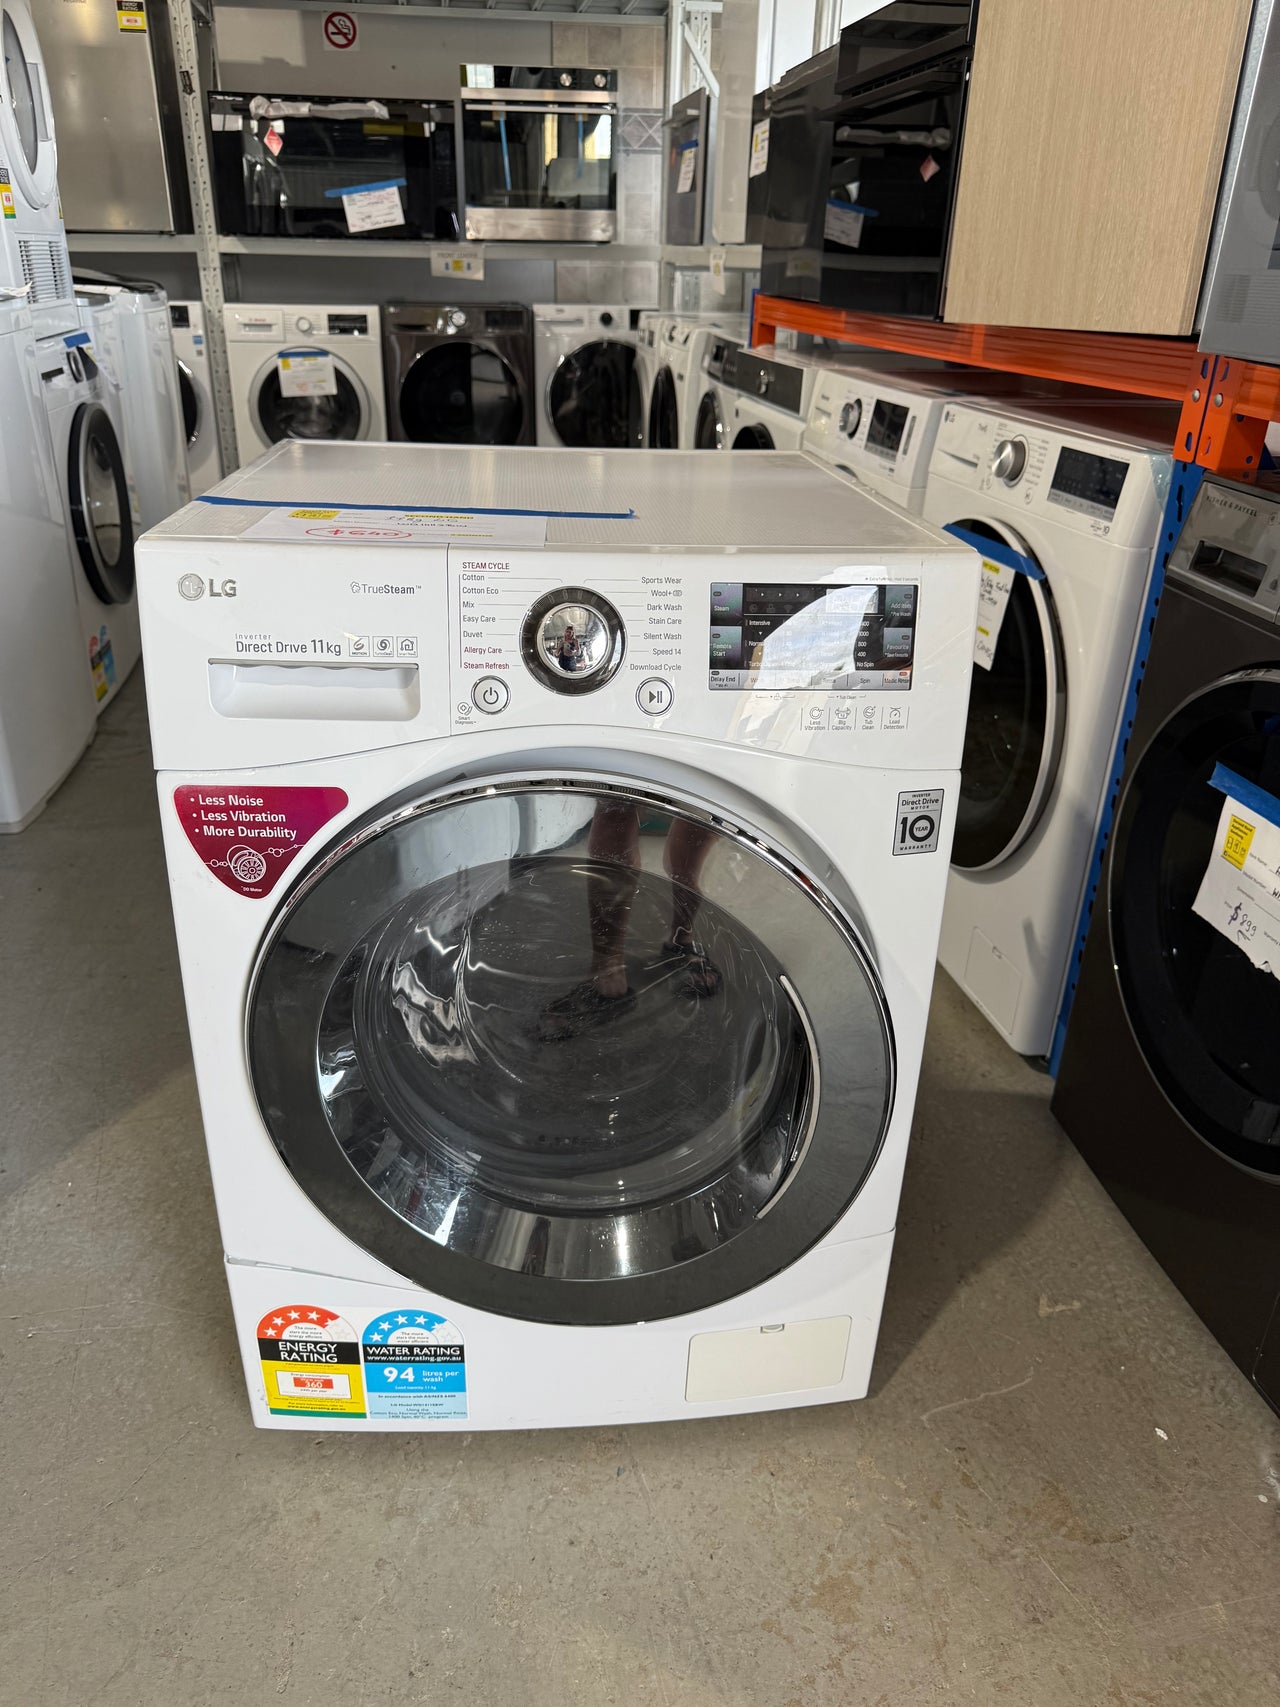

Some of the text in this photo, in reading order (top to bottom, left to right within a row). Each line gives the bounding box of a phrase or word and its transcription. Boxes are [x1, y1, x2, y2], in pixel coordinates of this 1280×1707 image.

[462, 561, 510, 570] STEAM CYCLE
[462, 573, 485, 581] Cotton
[641, 576, 682, 585] Sports Wear
[208, 577, 237, 598] LG
[462, 587, 499, 595] Cotton Eco
[646, 603, 682, 611] Dark Wash
[462, 615, 496, 624] Easy Care
[648, 617, 682, 625] Stain Care
[235, 632, 272, 641] Inverter
[463, 630, 483, 638] Duvet
[643, 632, 682, 640] Silent Wash
[236, 639, 342, 656] Direct Drive 11kg
[463, 646, 486, 655] Allergy
[652, 648, 673, 656] Speed
[463, 662, 510, 670] Steam Refresh
[629, 663, 682, 672] Download Cycle
[199, 794, 264, 807] Less Noise
[201, 810, 286, 822] Less Vibration
[203, 825, 297, 841] More Durability
[900, 814, 935, 844] 10
[278, 1341, 338, 1353] ENERGY
[366, 1346, 460, 1356] WATER RATING
[280, 1351, 338, 1363] RATING
[383, 1367, 415, 1383] 94
[305, 1381, 323, 1389] 360
